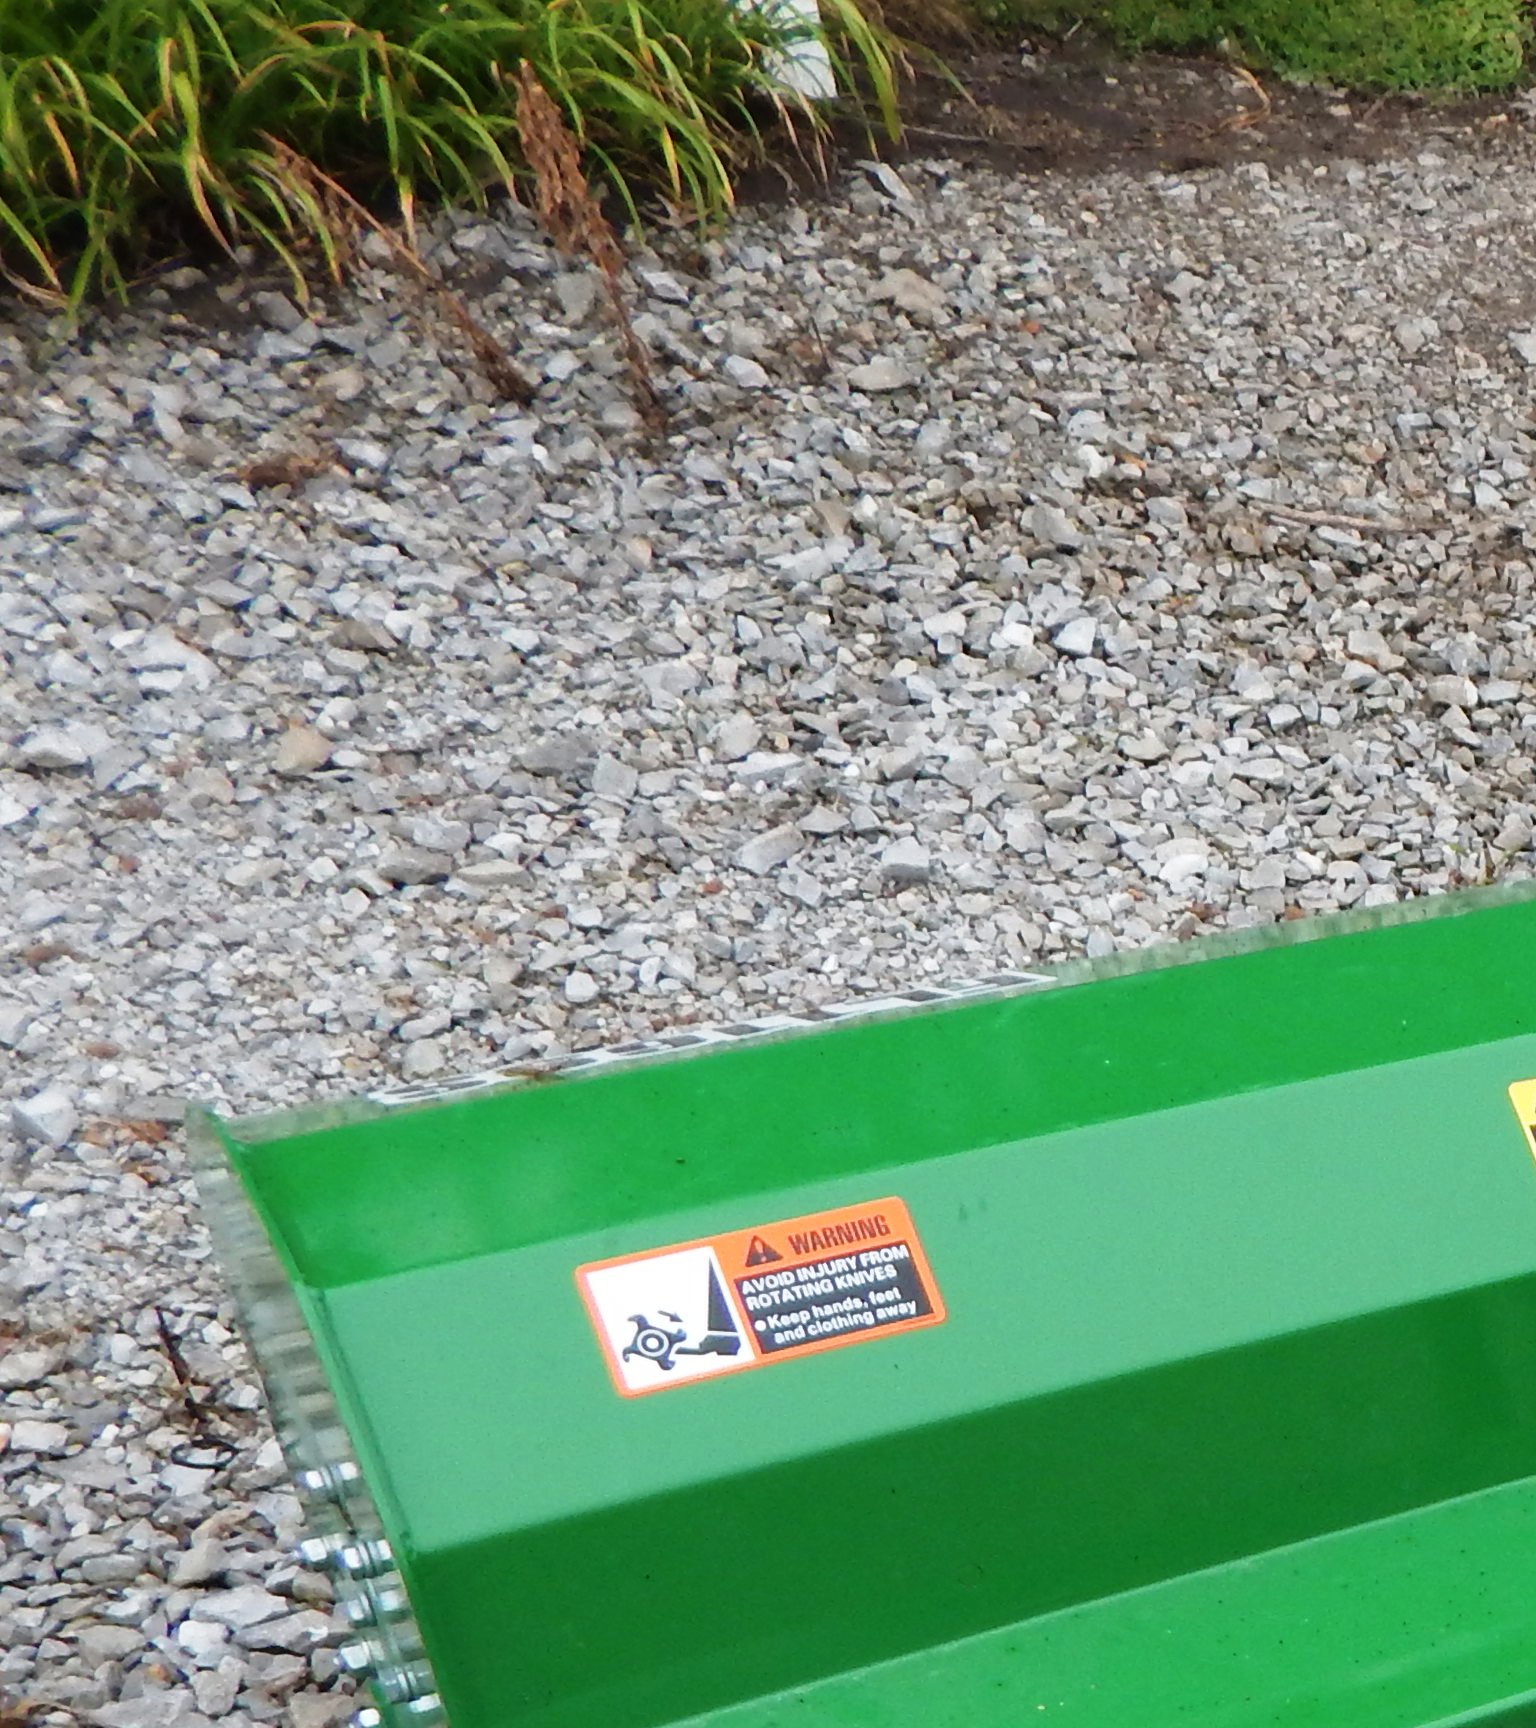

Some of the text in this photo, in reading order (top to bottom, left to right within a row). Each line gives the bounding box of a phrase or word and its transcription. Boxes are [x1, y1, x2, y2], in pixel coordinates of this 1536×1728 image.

[788, 1215, 891, 1255] WARNING
[742, 1245, 909, 1295] AVOID INJURY FROM
[746, 1264, 897, 1311] ROTATING KNIVES
[767, 1287, 901, 1329] Keep hands, feet
[774, 1301, 917, 1344] and clothing away
